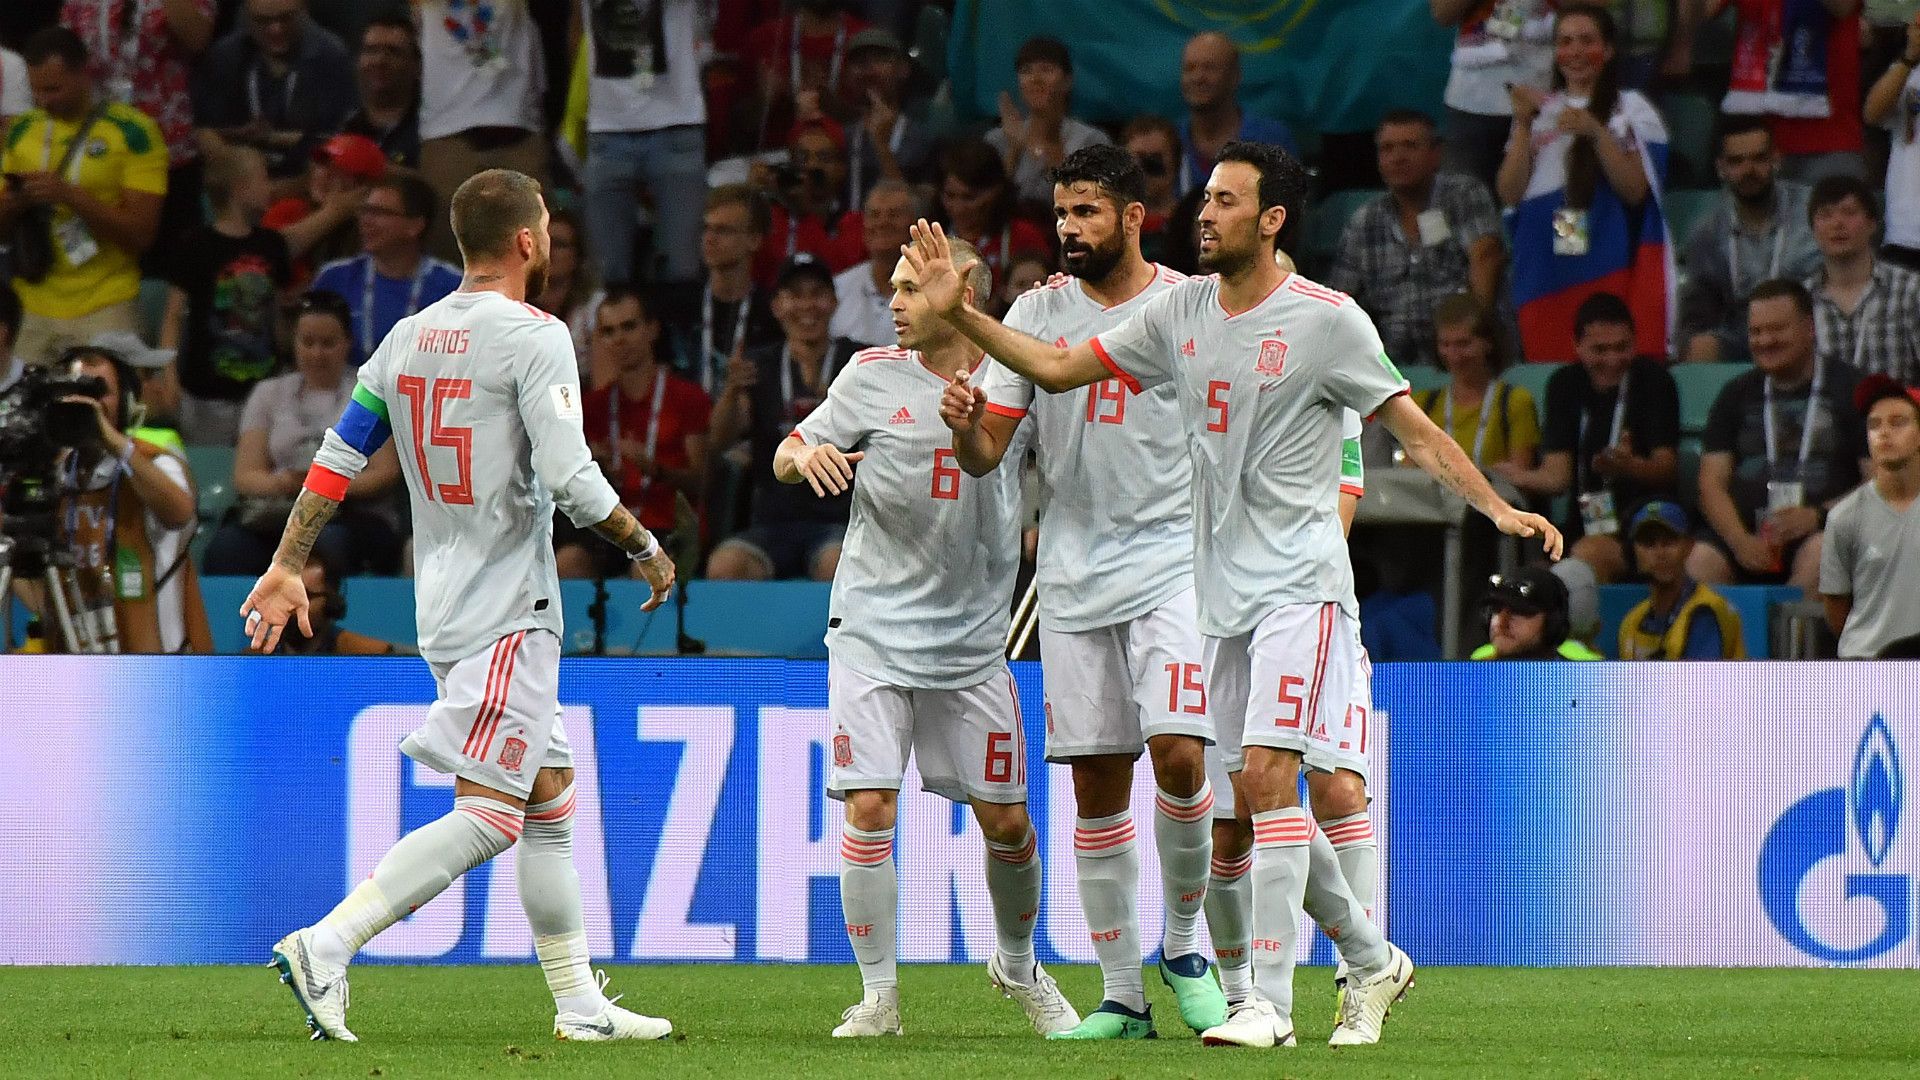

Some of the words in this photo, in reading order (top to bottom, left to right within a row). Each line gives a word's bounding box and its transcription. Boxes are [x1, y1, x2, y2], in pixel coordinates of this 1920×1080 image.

[1086, 379, 1127, 425] 19
[1207, 380, 1232, 434] 5
[397, 374, 475, 506] 15
[931, 447, 961, 500] 6
[1275, 675, 1305, 728] 5
[984, 732, 1012, 782] 6
